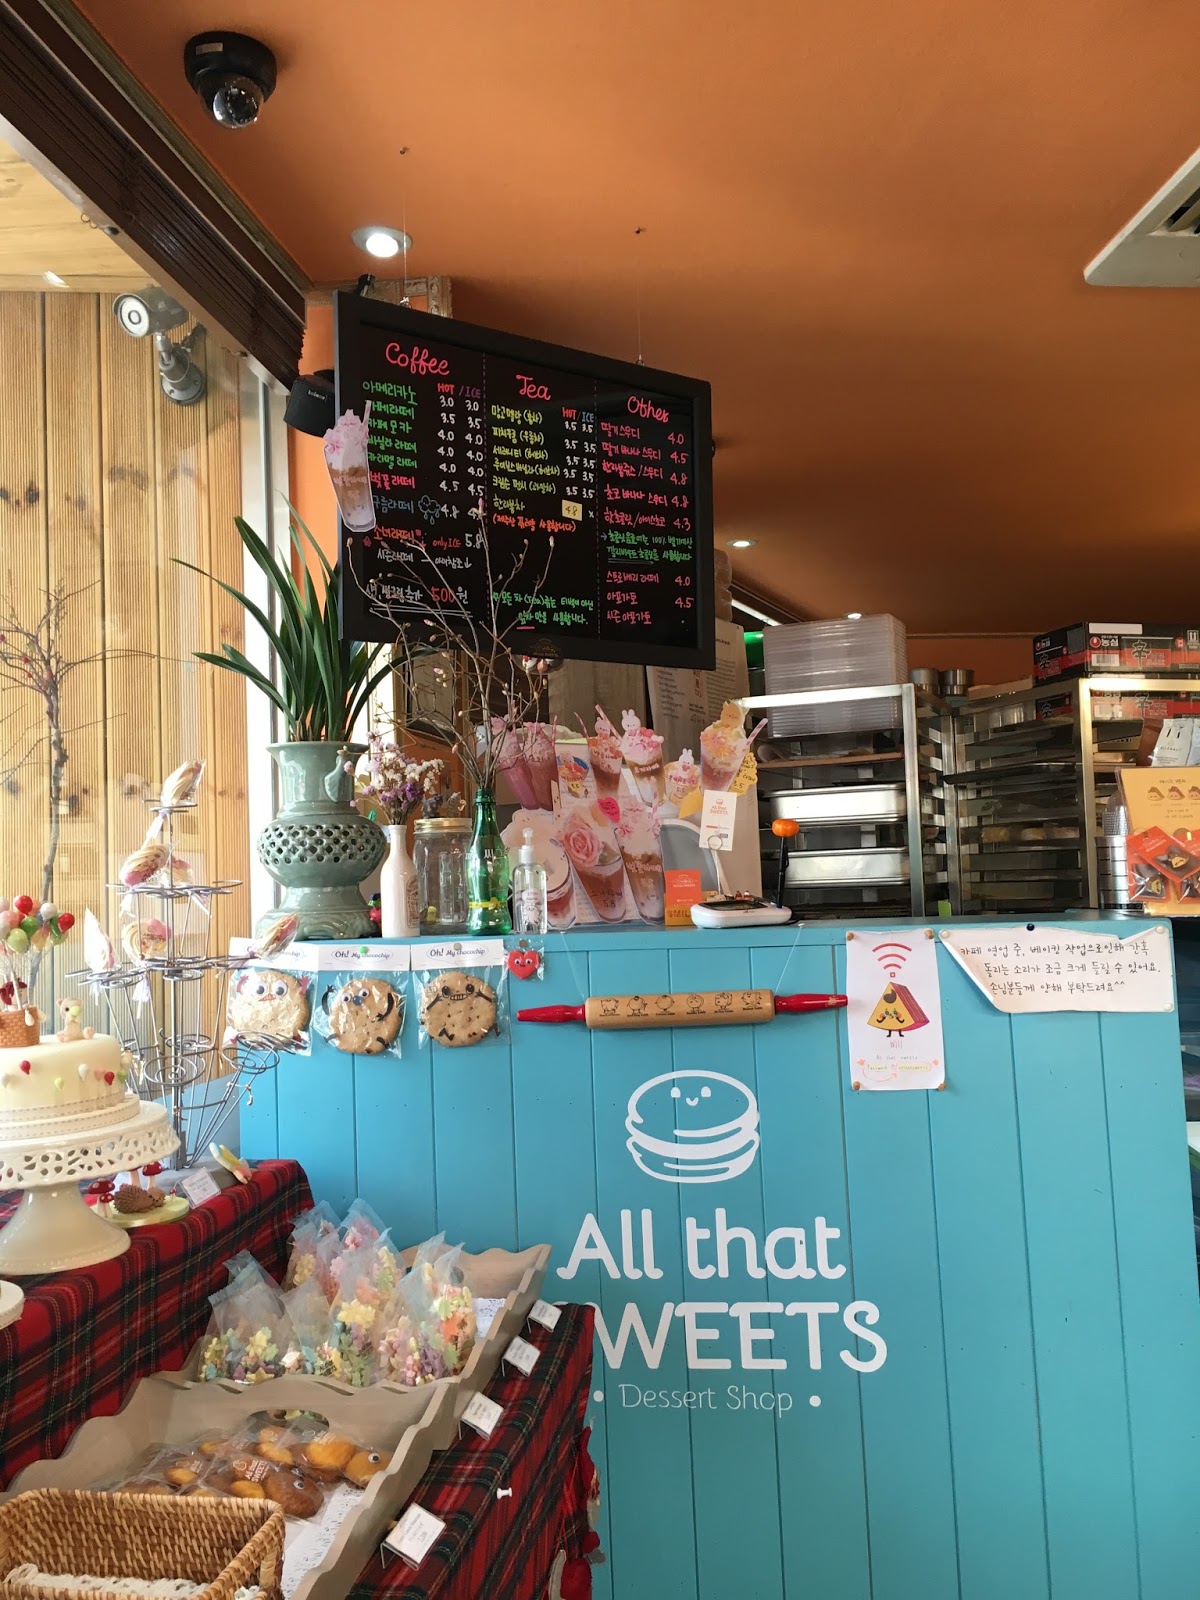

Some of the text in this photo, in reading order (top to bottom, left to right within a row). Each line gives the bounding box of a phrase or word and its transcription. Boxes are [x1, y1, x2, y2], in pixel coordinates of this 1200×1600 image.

[386, 342, 450, 375] Coffee
[437, 382, 455, 395] HOT
[516, 374, 551, 400] Tea
[362, 380, 480, 412] 아메리카노 3.0 3.0
[562, 406, 577, 420] HOT
[628, 396, 669, 422] Other
[440, 412, 456, 424] 3.5
[468, 417, 482, 430] 3.5
[565, 420, 578, 431] 3.5
[582, 424, 594, 434] 3.5
[437, 429, 455, 441] 4.0
[465, 433, 483, 445] 4.0
[564, 439, 578, 450] 3.5
[584, 442, 596, 453] 3.5
[437, 446, 455, 457] 4.0
[466, 450, 484, 462] 4.0
[670, 450, 689, 464] 4.5
[566, 456, 580, 466] 3.5
[582, 458, 596, 469] 3.5
[439, 463, 456, 474] 4.0
[468, 466, 484, 478] 4.0
[563, 468, 577, 478] 3.5
[582, 471, 594, 483] 3.5
[392, 474, 415, 489] 라떼
[439, 480, 460, 492] 4.5
[468, 483, 485, 497] 4.5
[670, 472, 688, 486] 4.8
[566, 486, 578, 496] 3.5
[582, 488, 596, 499] 3.5
[672, 495, 690, 508] 4.8
[441, 504, 460, 518] 4.8
[673, 518, 692, 532] 4.3
[675, 576, 691, 586] 4.0
[675, 596, 695, 608] 4.5
[335, 950, 350, 958] Oh!
[430, 947, 444, 957] Oh!
[960, 946, 982, 956] 카페
[987, 945, 1009, 958] 영업
[1030, 944, 1060, 956] 베이킹
[1129, 940, 1150, 956] 간혹
[984, 962, 1010, 977] 돌리는
[1014, 964, 1041, 974] 소리가
[1046, 962, 1062, 975] 조금
[1066, 964, 1087, 974] 크게
[1092, 960, 1110, 975] 들릴
[1114, 962, 1124, 974] 수
[990, 981, 1036, 996] 손님분들께
[1040, 984, 1062, 994] 양해
[556, 1208, 846, 1280] All that
[558, 1300, 888, 1372] WEETS
[618, 1384, 793, 1418] Dessert Shop
